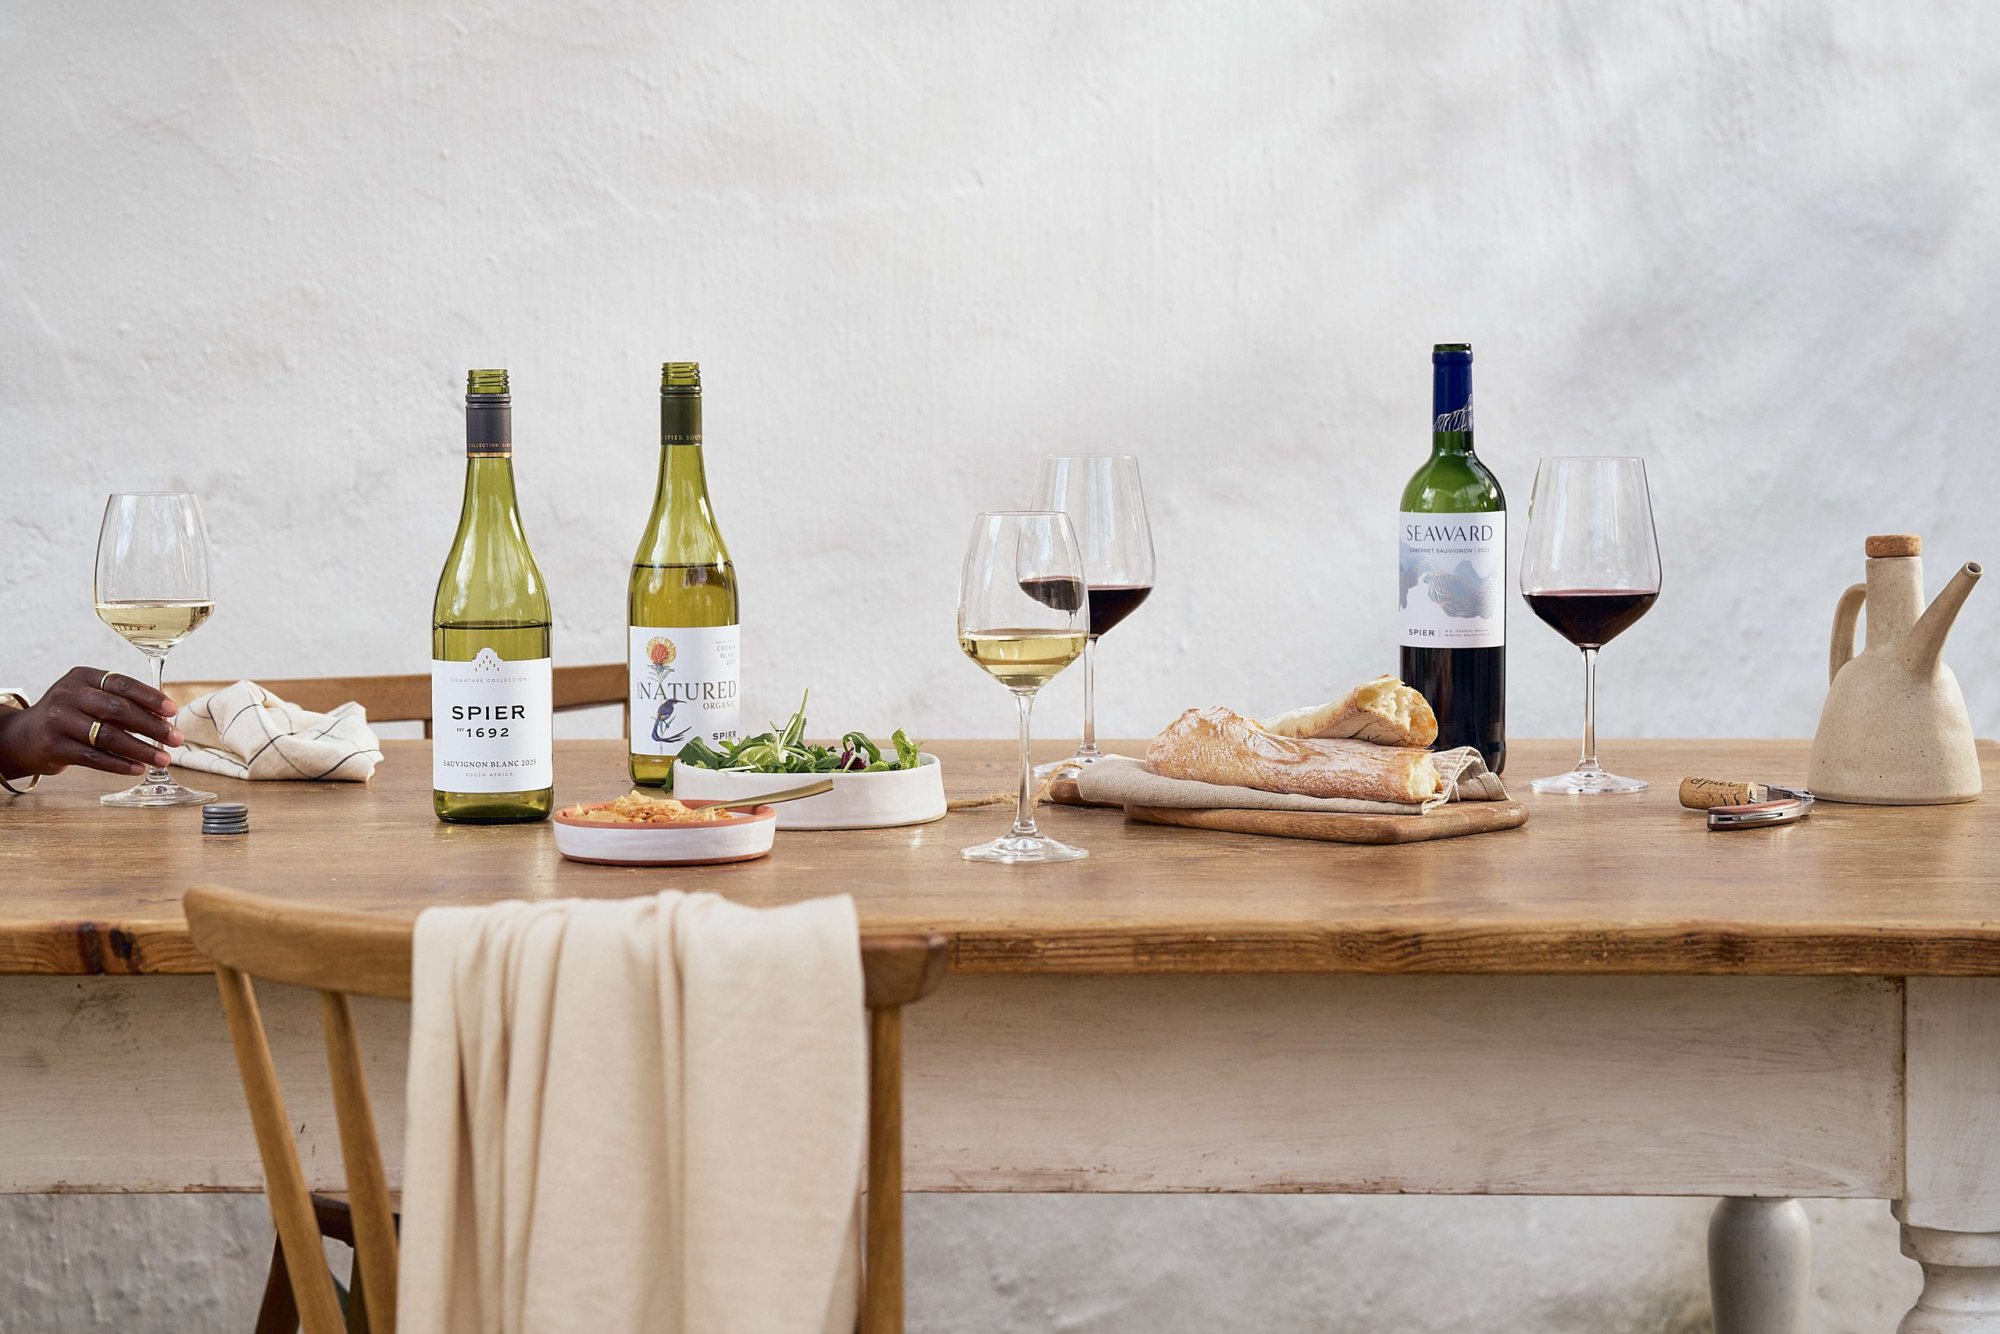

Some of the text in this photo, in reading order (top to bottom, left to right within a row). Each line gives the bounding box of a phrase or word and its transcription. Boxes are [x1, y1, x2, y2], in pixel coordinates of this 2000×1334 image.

[1406, 524, 1493, 542] SEAWARD
[1408, 628, 1435, 637] SPIER
[640, 680, 737, 701] NATURED
[451, 704, 526, 721] SPIER
[466, 727, 510, 738] 1692
[712, 730, 737, 741] SPIER
[443, 759, 488, 768] SAUVIGNON
[490, 760, 519, 768] BLANC
